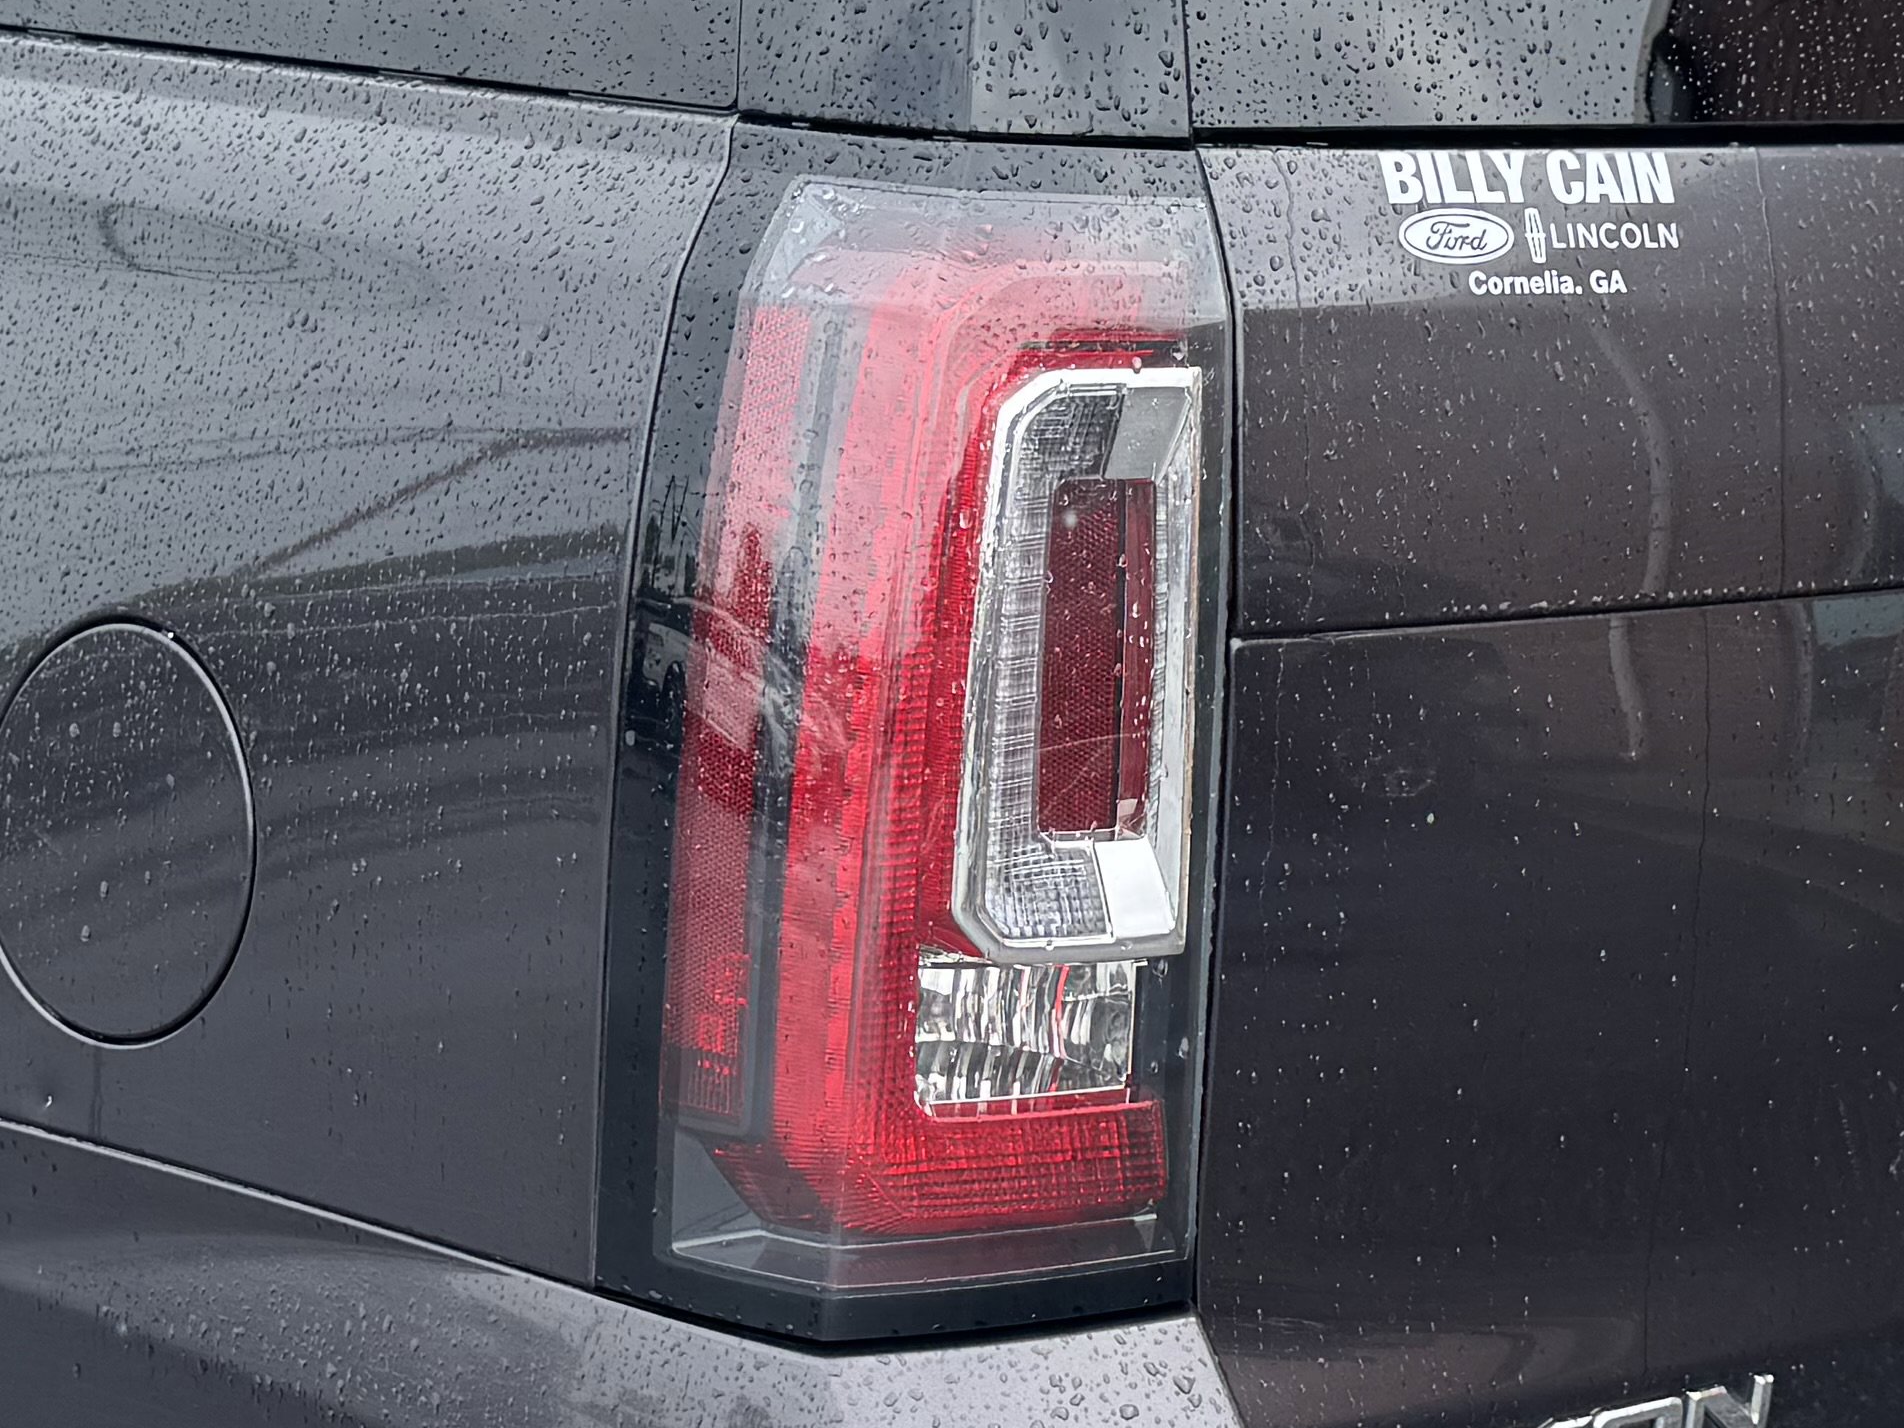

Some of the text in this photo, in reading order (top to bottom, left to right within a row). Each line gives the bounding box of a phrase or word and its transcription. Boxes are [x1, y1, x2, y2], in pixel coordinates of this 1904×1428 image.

[1378, 149, 1676, 204] BILLY CAIN
[1551, 222, 1680, 250] LINCOLN
[1589, 269, 1628, 295] GA
